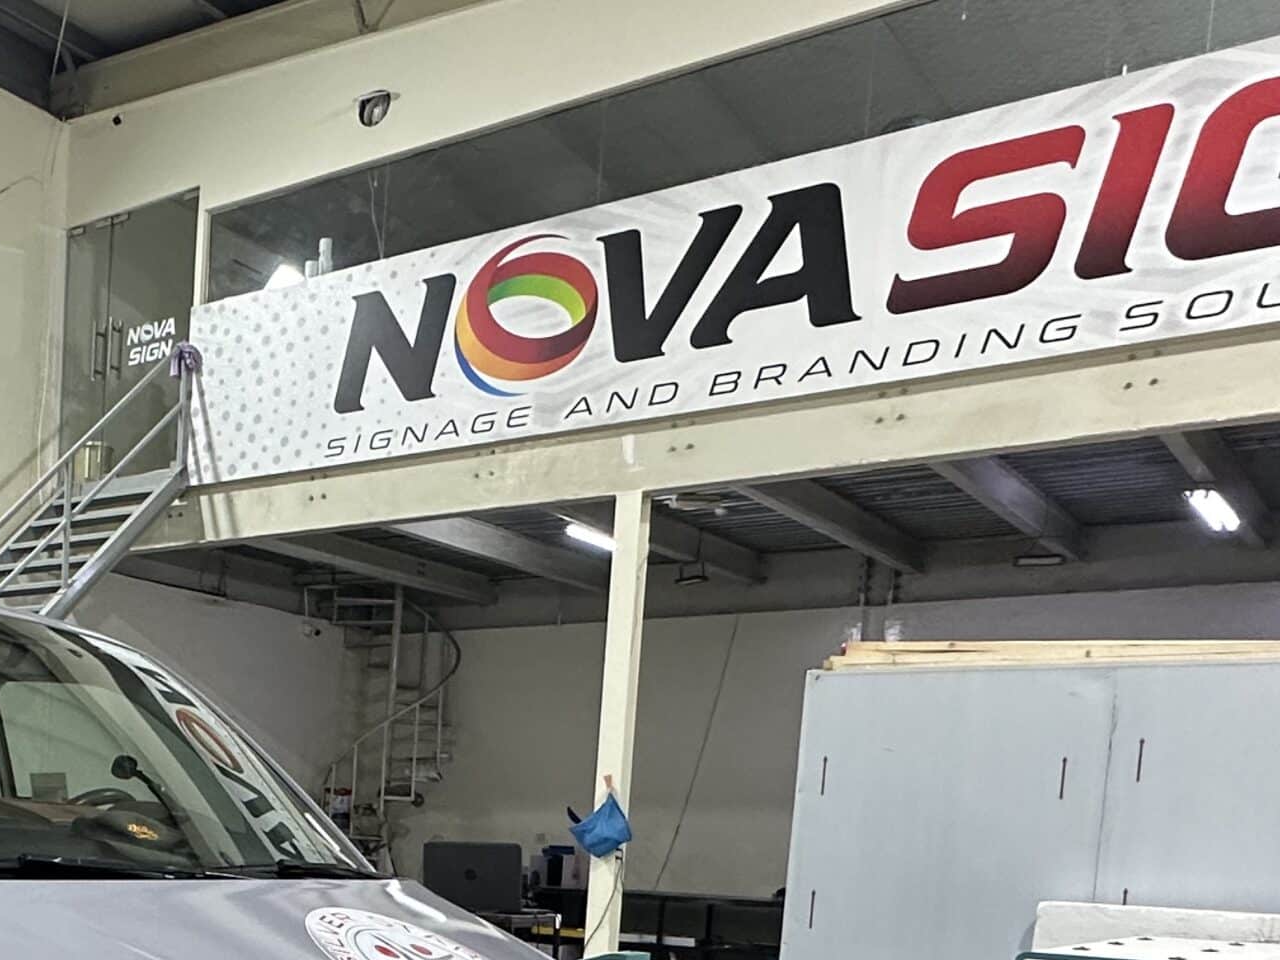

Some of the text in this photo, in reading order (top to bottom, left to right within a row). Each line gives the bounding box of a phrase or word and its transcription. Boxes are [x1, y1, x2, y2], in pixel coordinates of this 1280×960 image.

[127, 317, 176, 346] NOVA
[128, 339, 173, 366] SIGN
[324, 406, 532, 458] SIGNAGE
[564, 381, 679, 422] AND
[708, 313, 1082, 397] BRANDING
